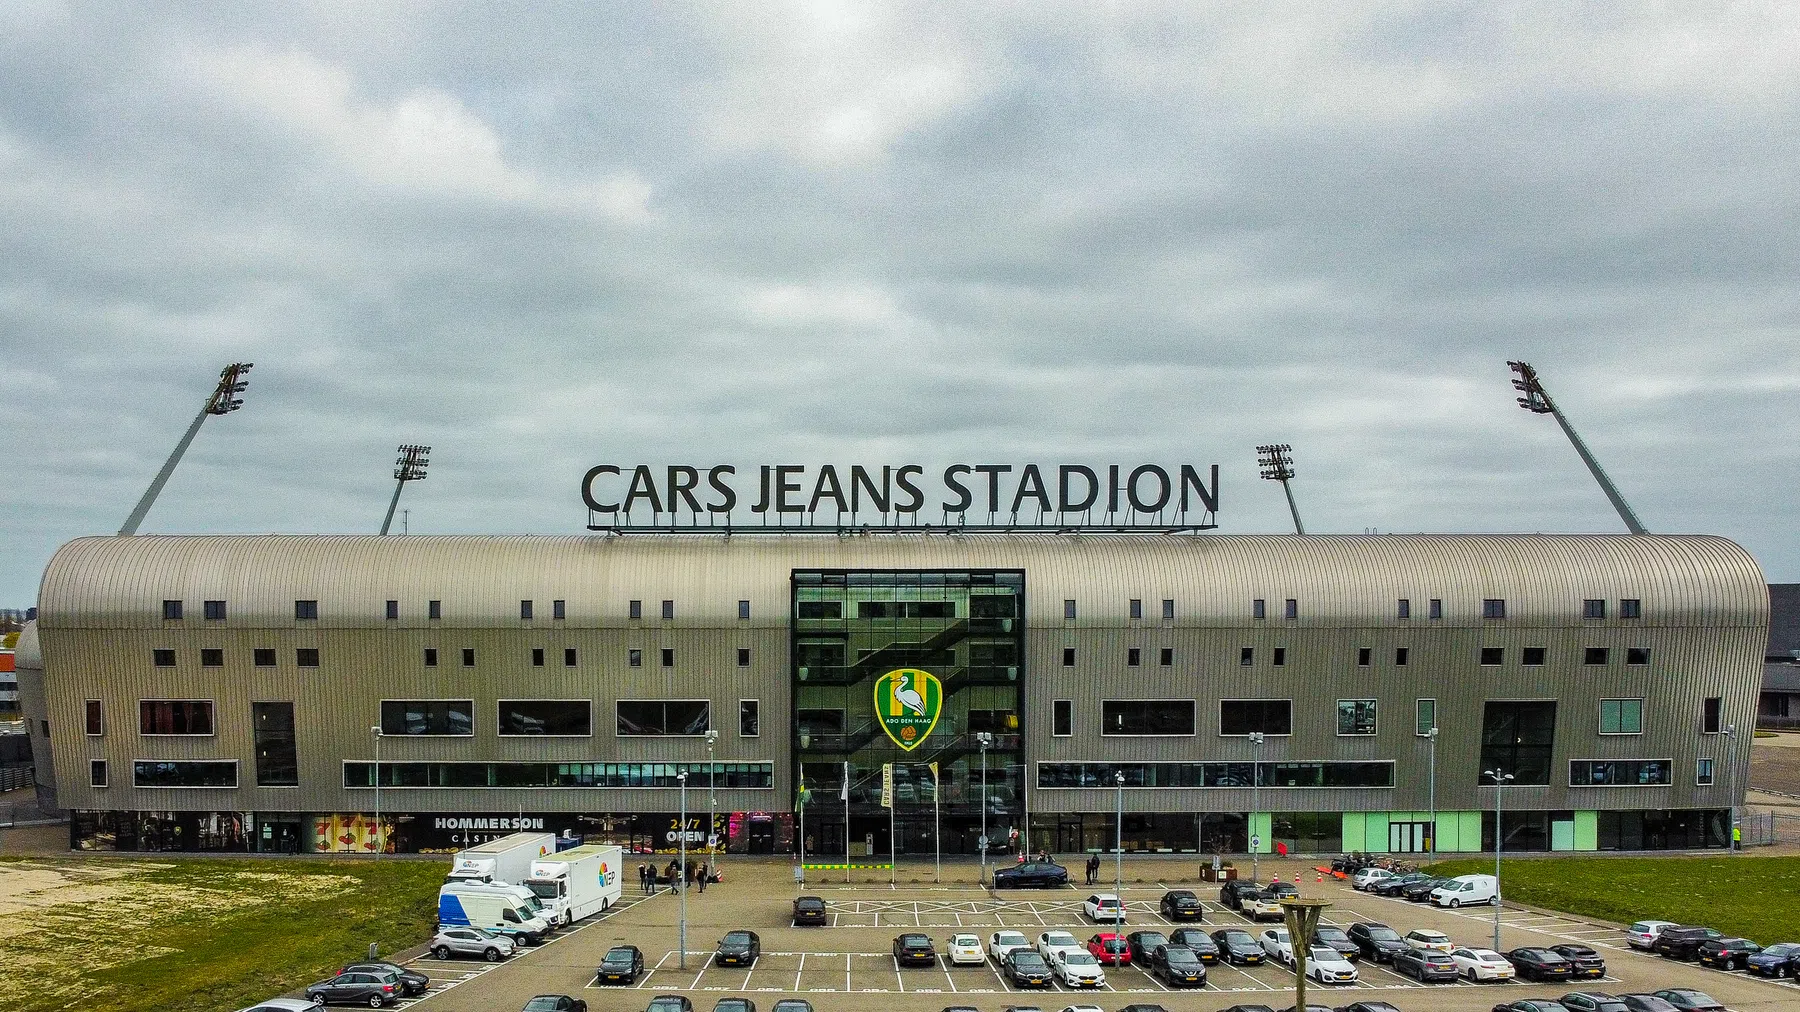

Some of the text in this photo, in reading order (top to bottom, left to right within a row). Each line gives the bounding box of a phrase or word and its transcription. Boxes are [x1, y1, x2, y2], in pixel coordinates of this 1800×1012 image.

[581, 464, 1219, 513] CARS JEANS STADION
[435, 817, 544, 829] HOMMERSON
[670, 817, 701, 830] 24/7
[451, 834, 501, 843] CASIN
[666, 830, 705, 842] OPEN
[604, 870, 616, 887] NEP
